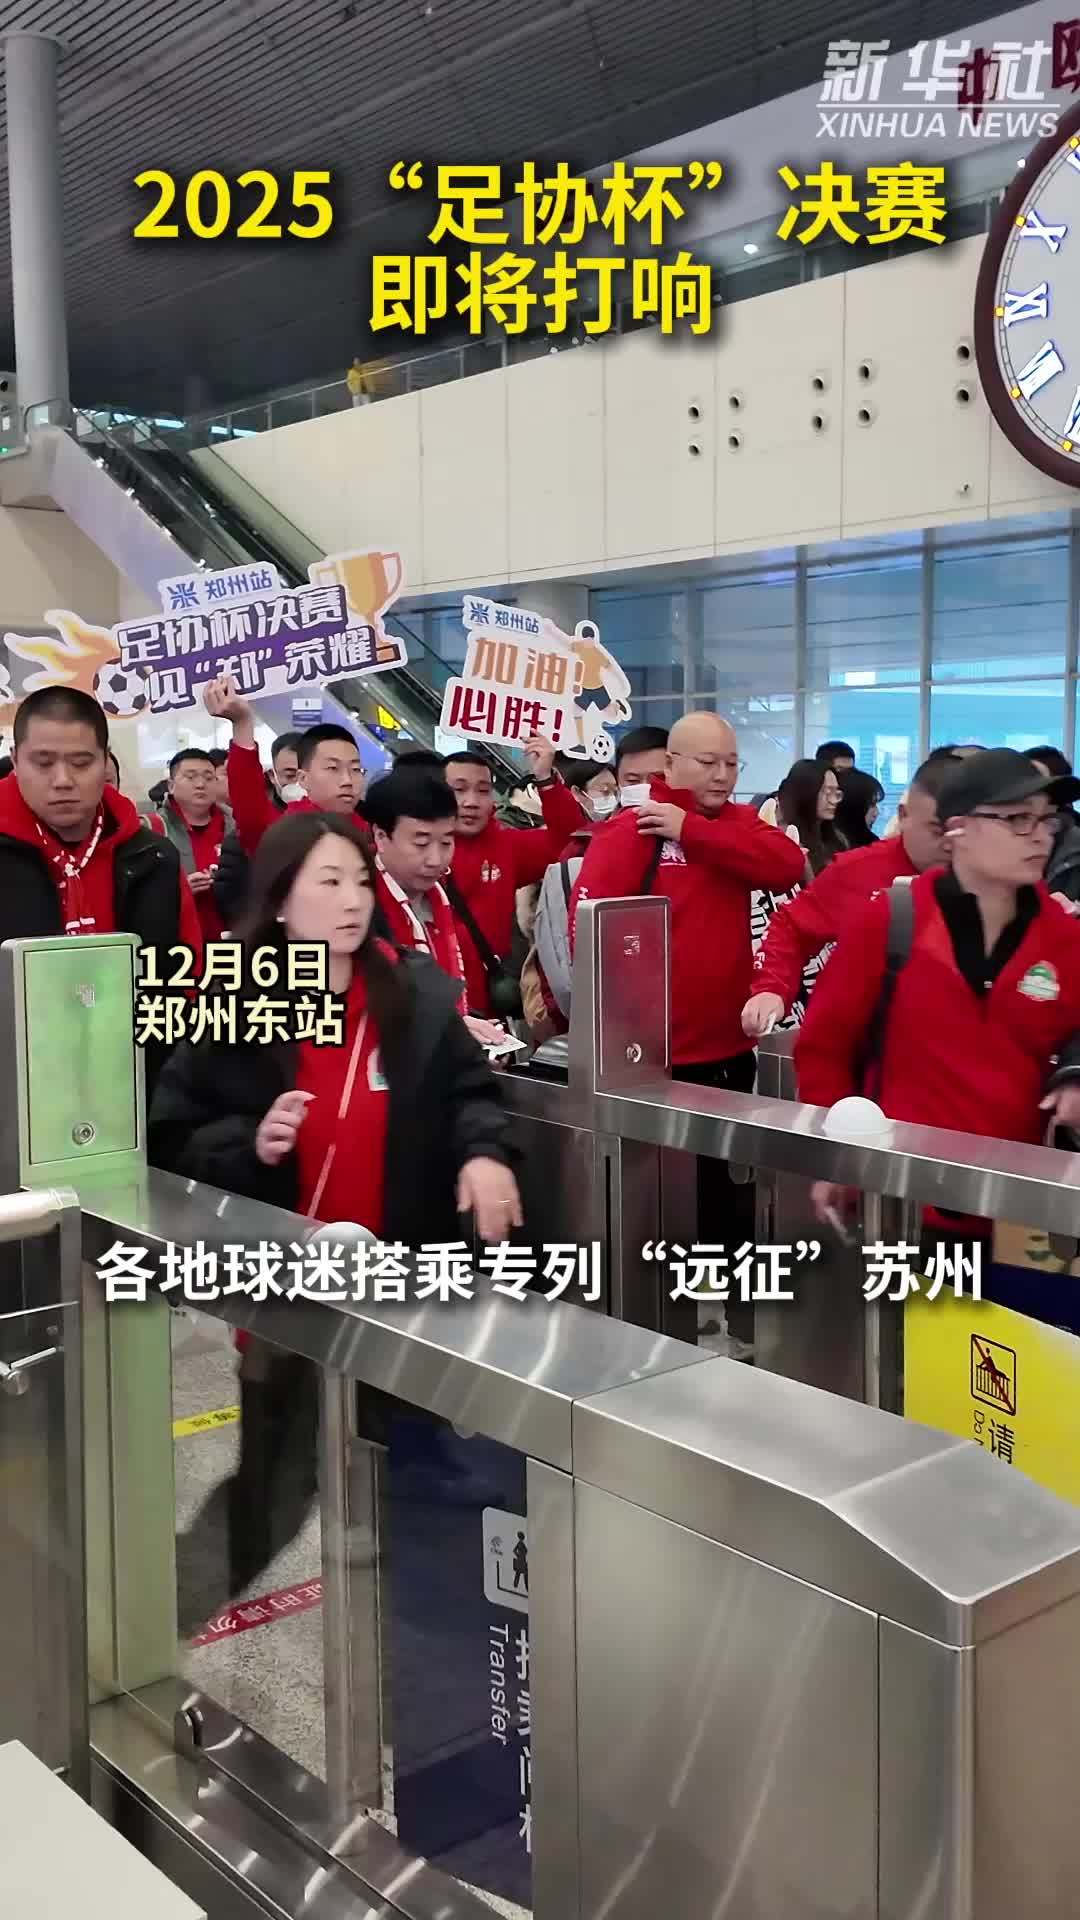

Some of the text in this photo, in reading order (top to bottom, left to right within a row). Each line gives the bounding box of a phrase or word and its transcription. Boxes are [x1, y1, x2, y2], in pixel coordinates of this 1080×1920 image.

[1020, 209, 1067, 253] X
[205, 568, 273, 601] 郑州站
[119, 585, 344, 668] 足协杯决赛
[495, 609, 540, 634] 郑州站
[448, 685, 563, 743] 必胜！
[489, 1622, 510, 1746] Transfer
